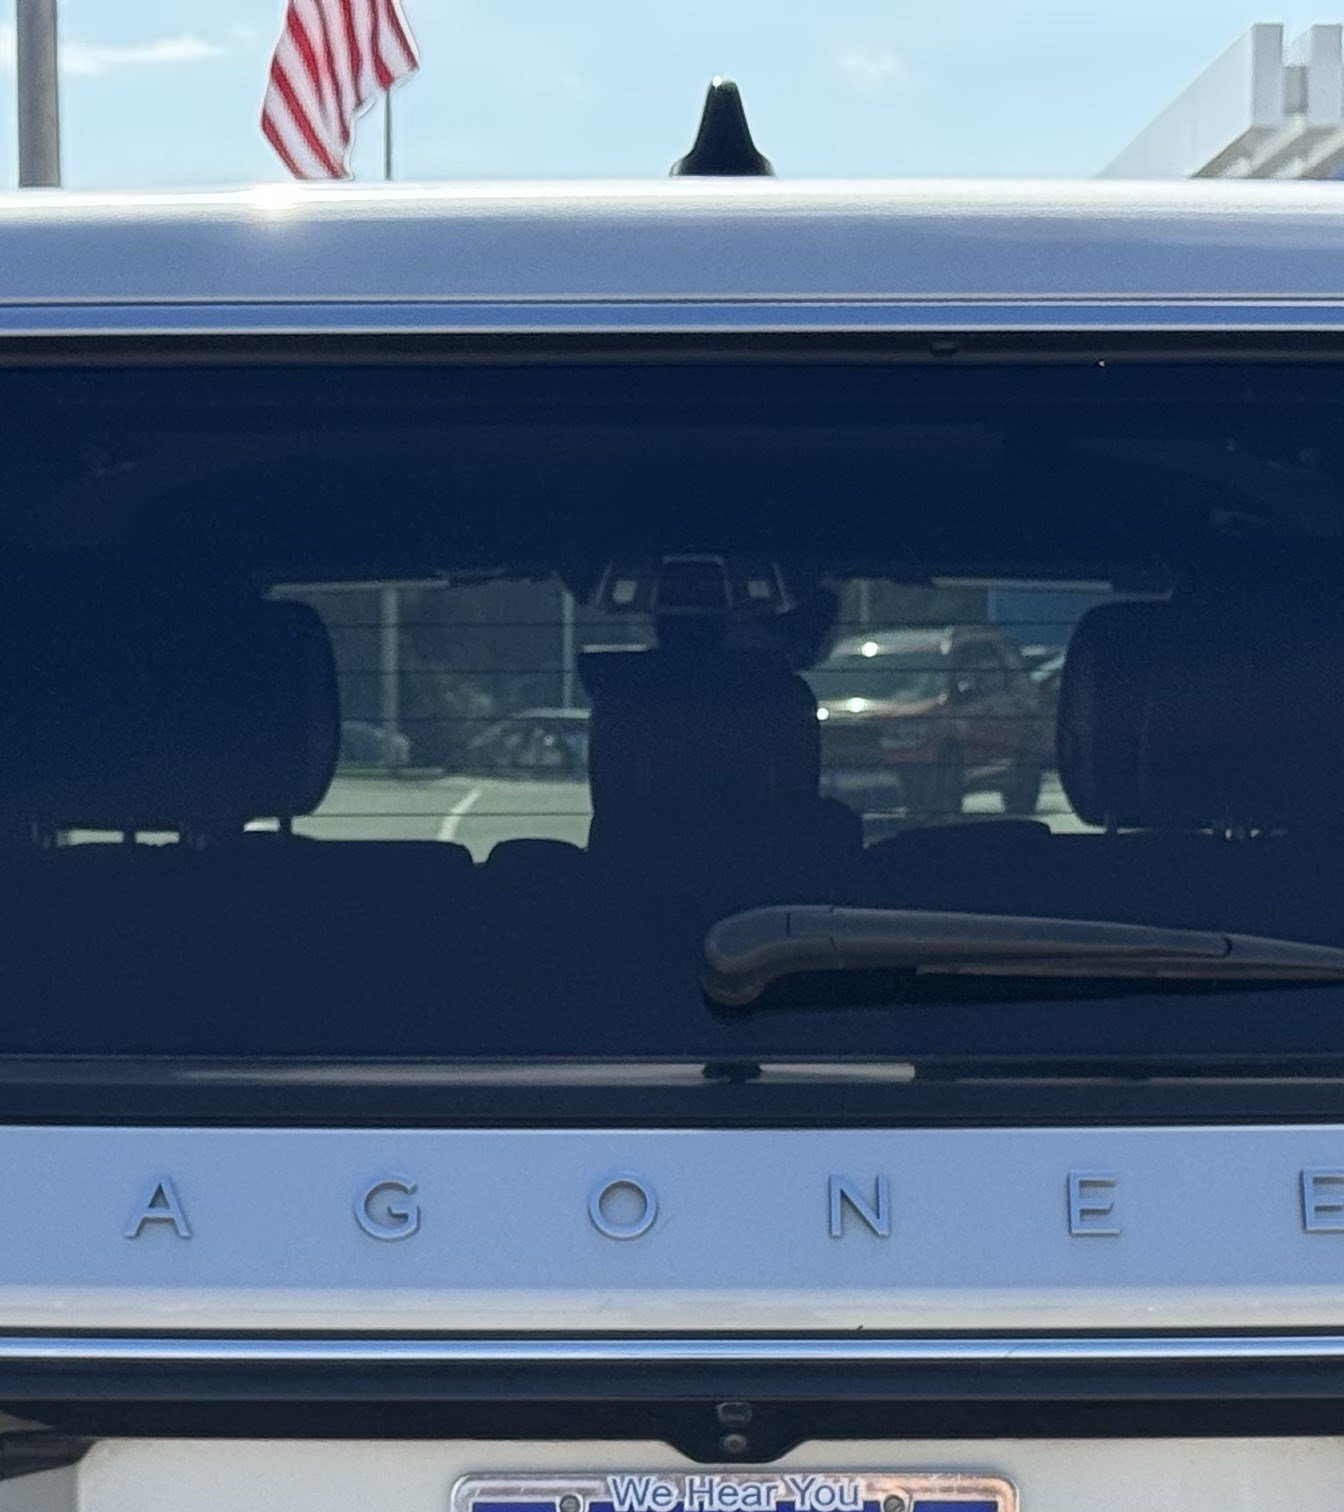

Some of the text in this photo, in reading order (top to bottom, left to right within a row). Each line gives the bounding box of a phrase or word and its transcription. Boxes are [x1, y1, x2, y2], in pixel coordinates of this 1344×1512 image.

[609, 1475, 862, 1508] We Hear You
